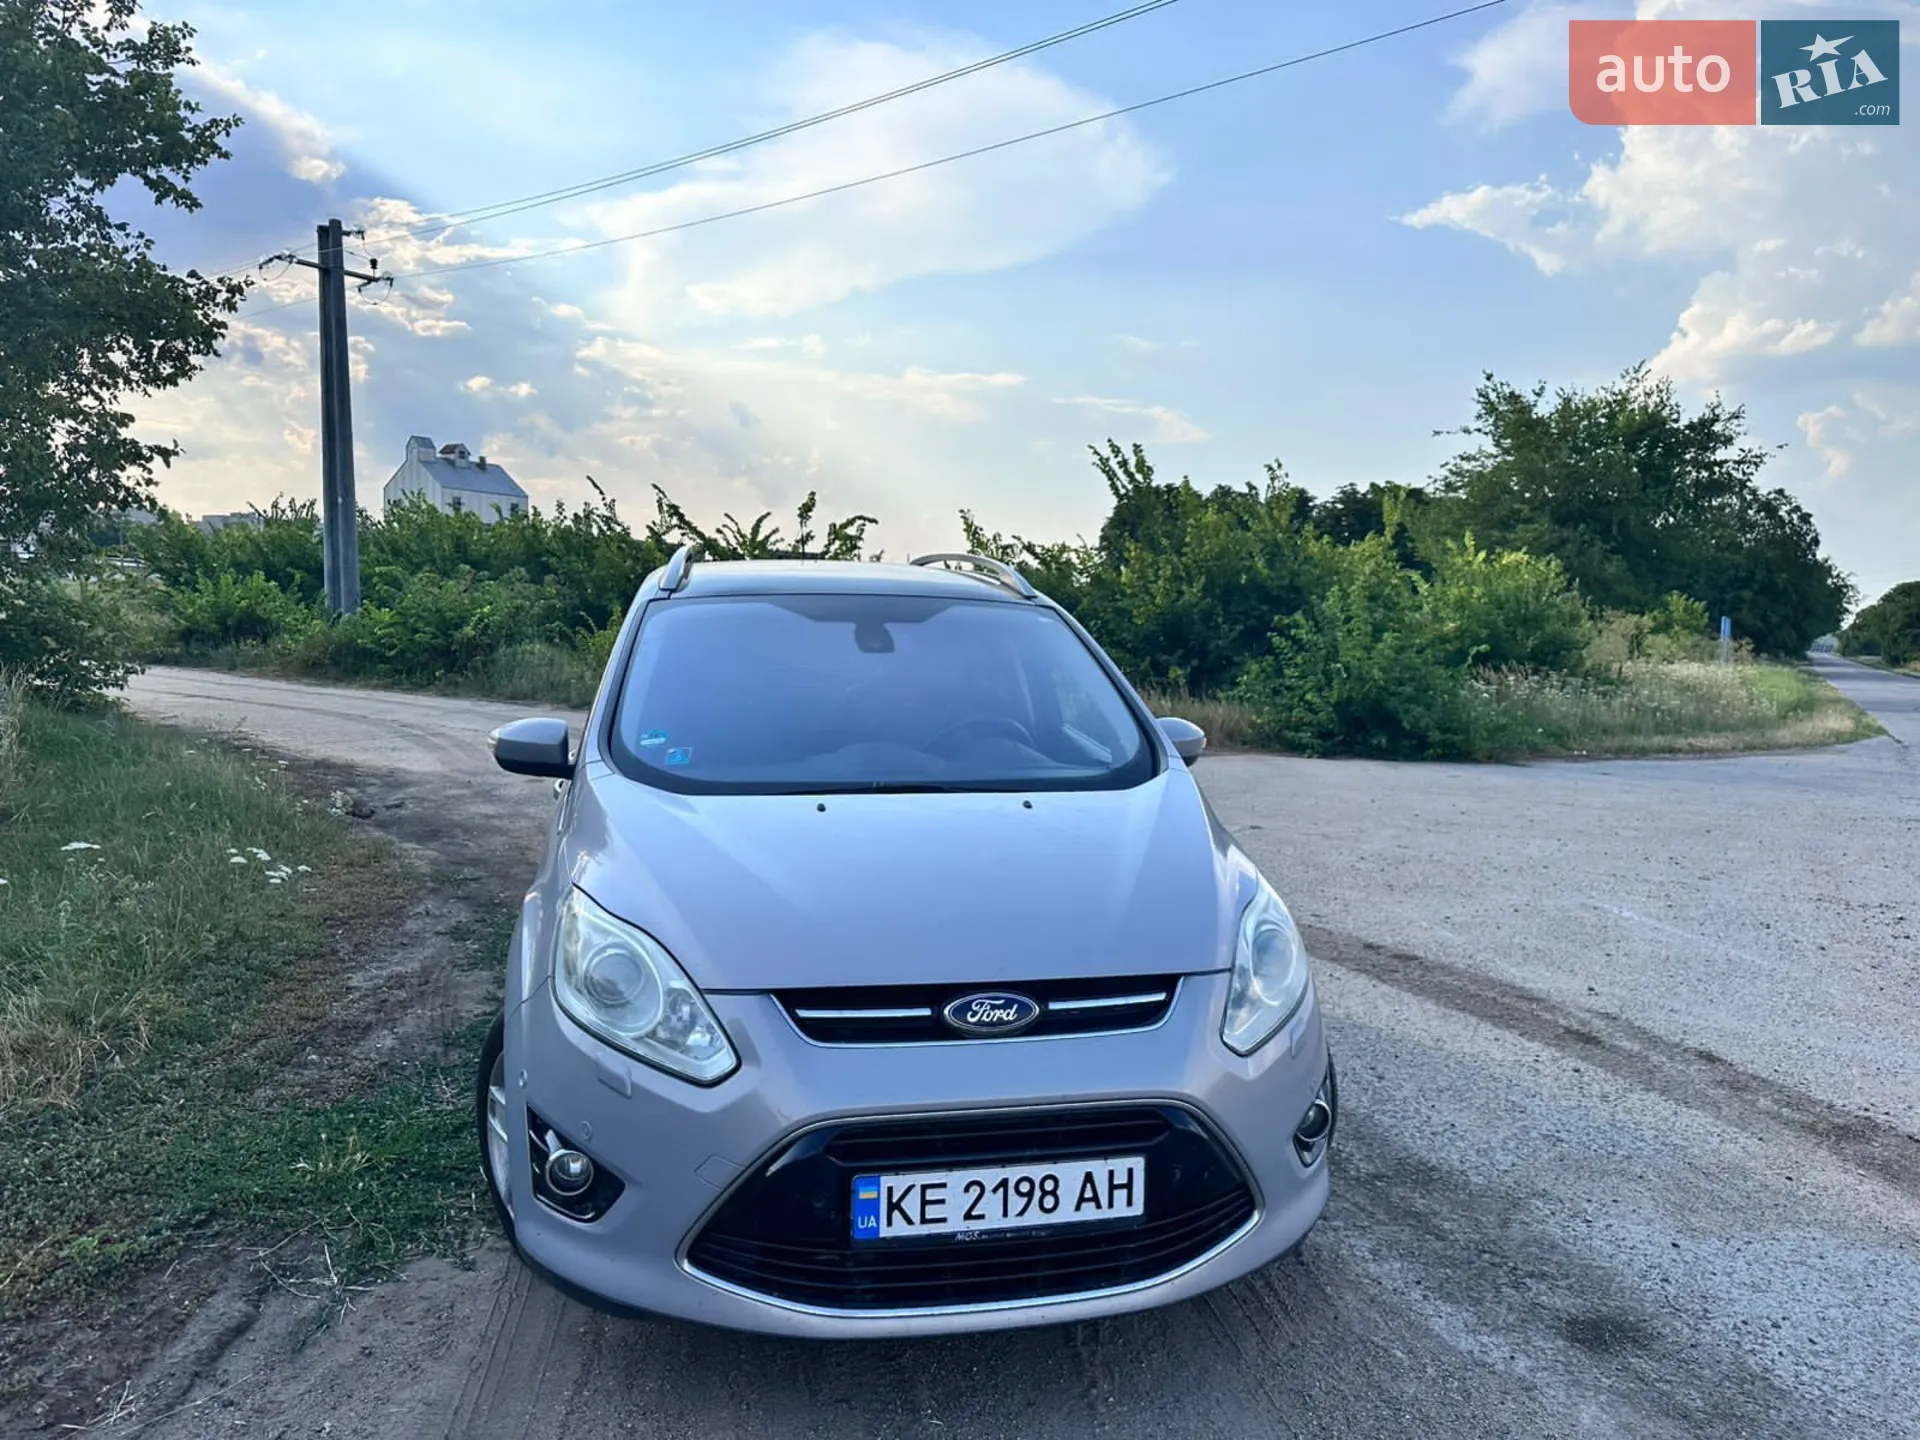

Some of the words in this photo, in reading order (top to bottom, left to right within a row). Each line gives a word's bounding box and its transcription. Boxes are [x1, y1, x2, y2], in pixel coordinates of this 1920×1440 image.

[966, 999, 1018, 1023] Ford
[886, 1182, 947, 1228] KE
[963, 1173, 1060, 1222] 2198
[1074, 1167, 1134, 1212] AH
[858, 1216, 878, 1229] UA
